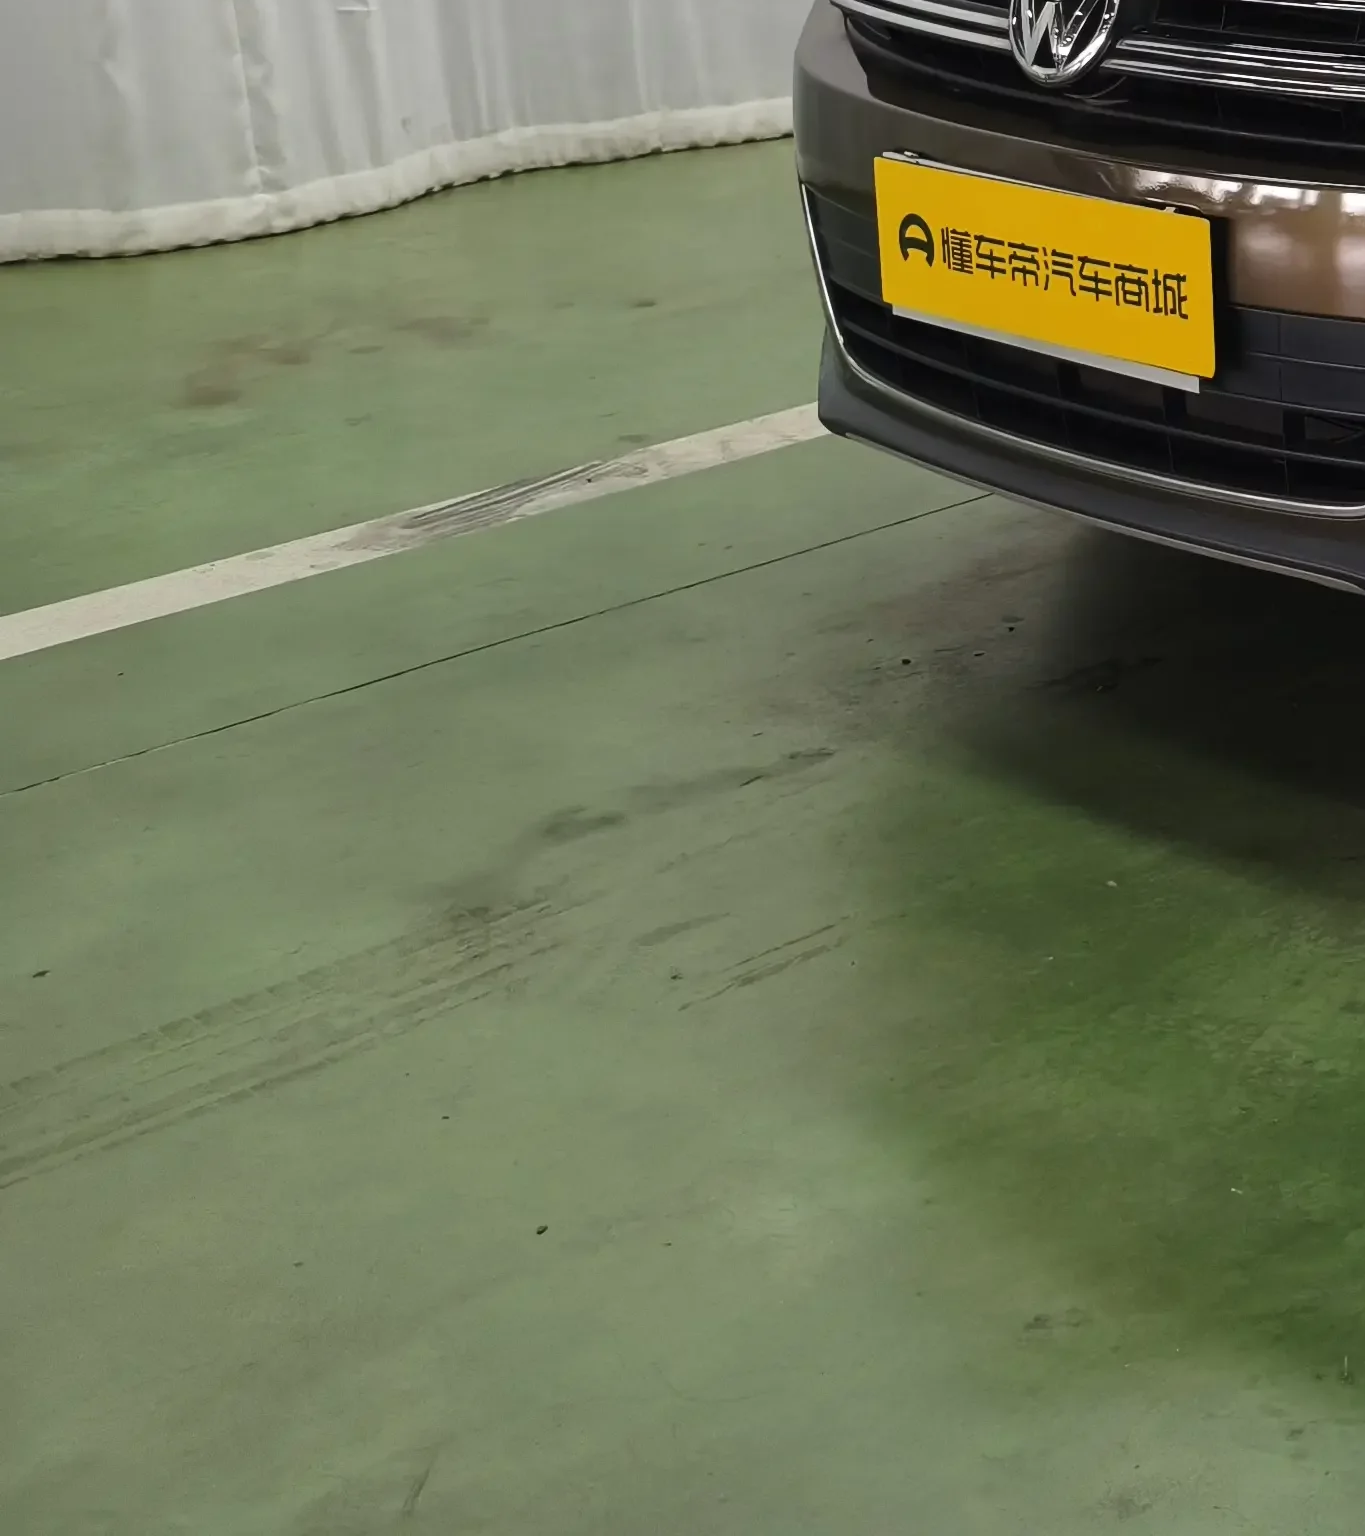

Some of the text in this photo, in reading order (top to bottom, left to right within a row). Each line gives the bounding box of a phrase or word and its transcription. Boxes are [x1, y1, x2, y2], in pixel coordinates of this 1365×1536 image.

[941, 227, 1188, 319] 懂车帝汽车商城
